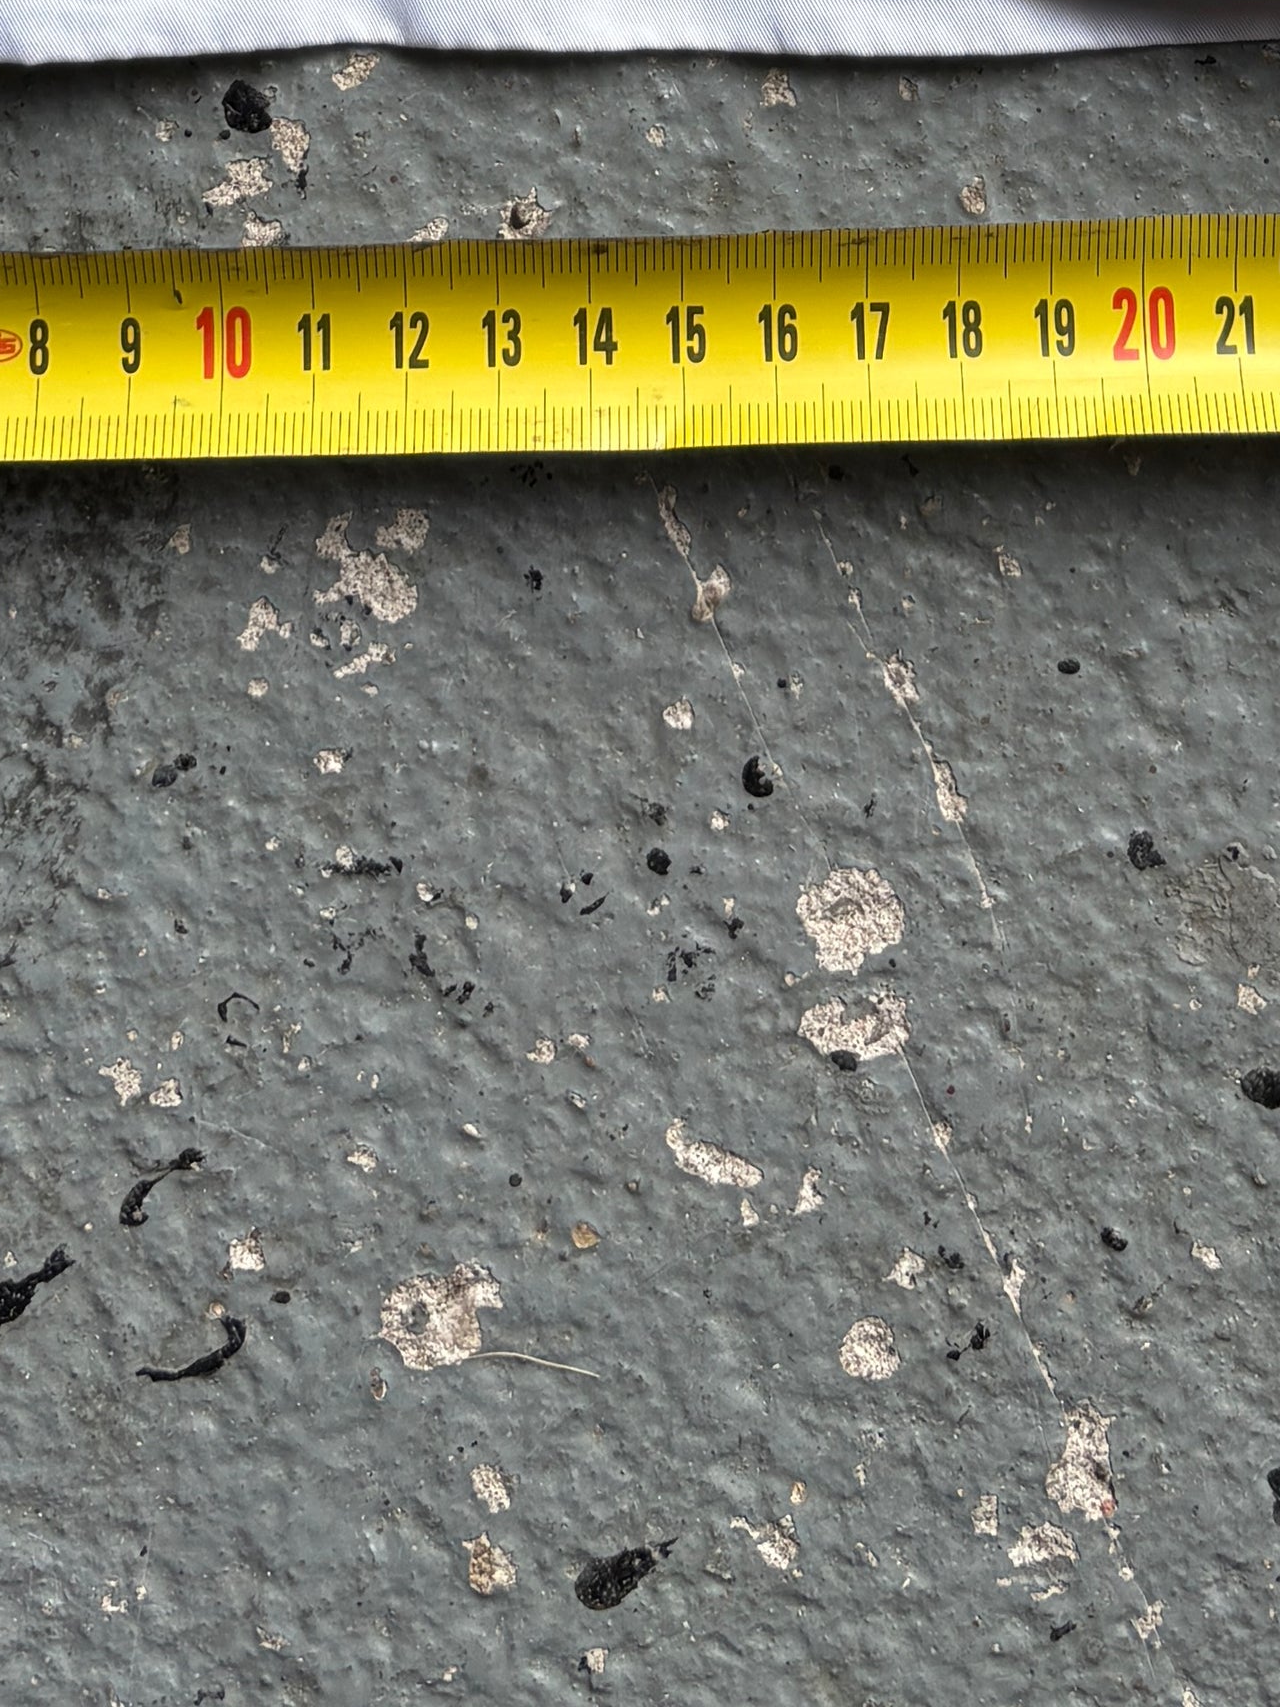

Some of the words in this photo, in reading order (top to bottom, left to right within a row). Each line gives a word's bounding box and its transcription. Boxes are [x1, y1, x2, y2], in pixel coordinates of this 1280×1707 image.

[29, 318, 49, 375] 8
[121, 317, 141, 374] 9
[196, 306, 252, 379] 10
[297, 314, 331, 371] 11
[389, 312, 429, 369] 12
[482, 309, 521, 367] 13
[573, 307, 618, 365] 14
[666, 306, 706, 364] 15
[758, 304, 798, 362] 16
[850, 302, 890, 360] 17
[942, 300, 983, 358] 18
[1034, 298, 1075, 357] 19
[1112, 286, 1176, 360] 20
[1215, 296, 1255, 354] 21
